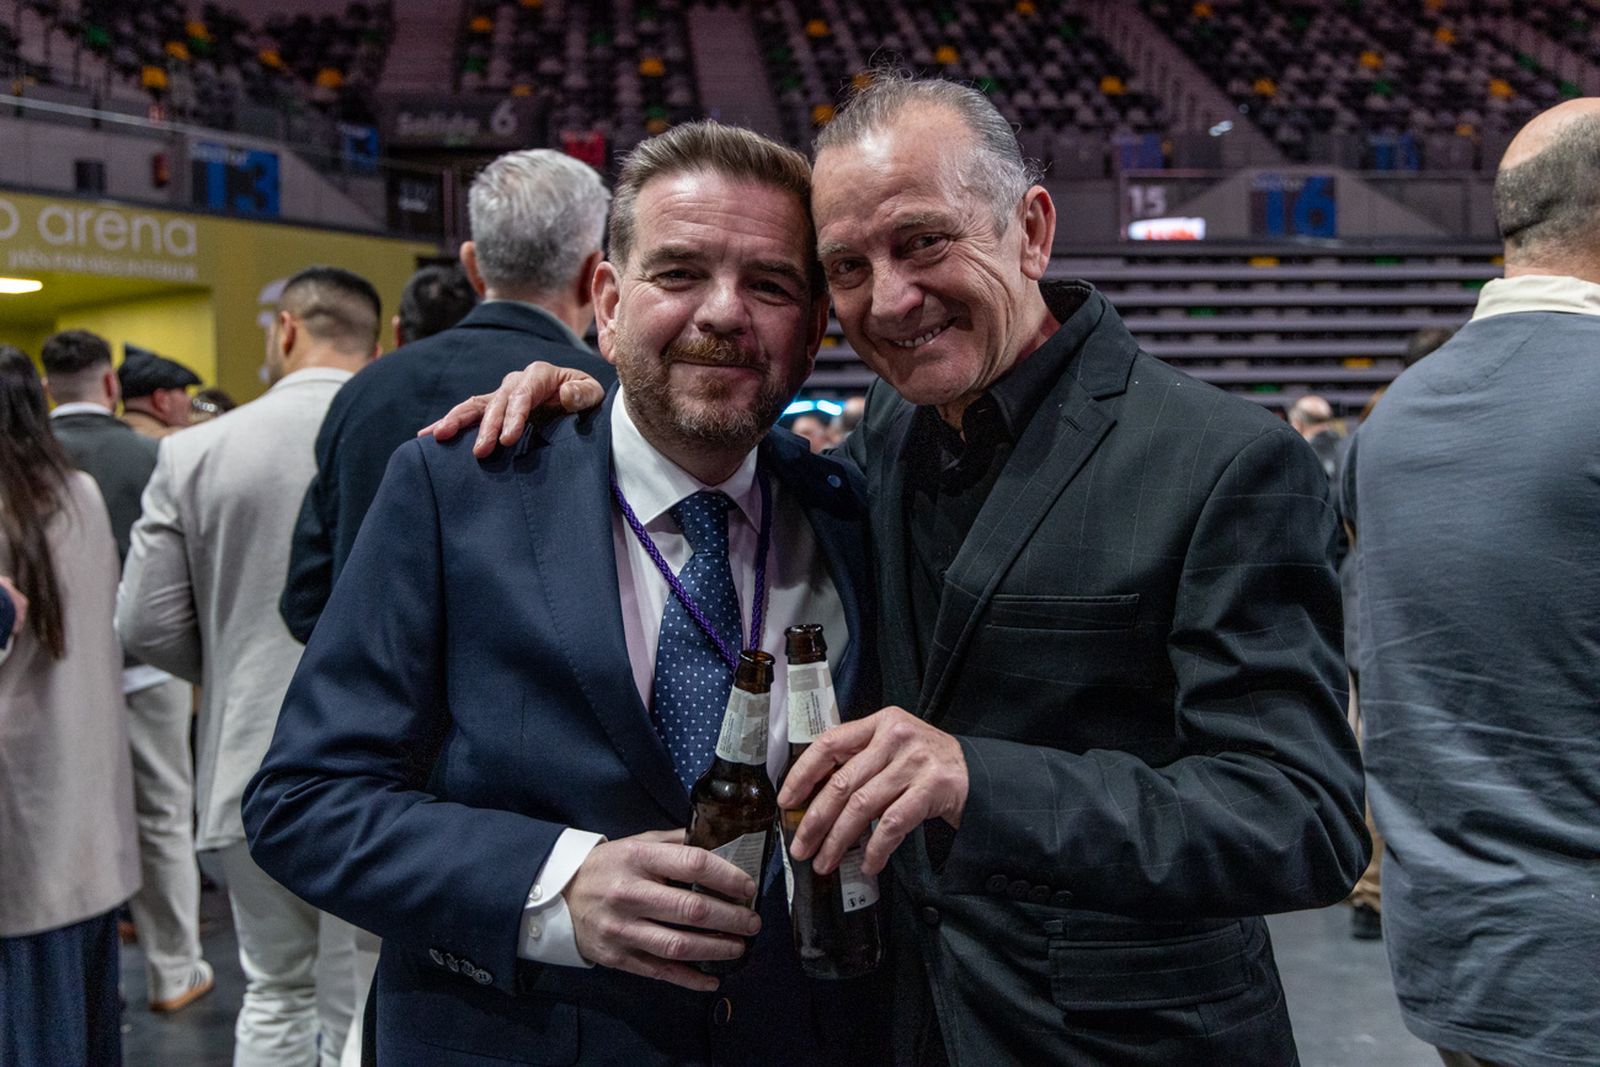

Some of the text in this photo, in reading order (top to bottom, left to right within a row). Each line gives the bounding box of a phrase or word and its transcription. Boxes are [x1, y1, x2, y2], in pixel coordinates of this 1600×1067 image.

[491, 99, 518, 136] 6
[206, 148, 280, 214] 13
[1129, 185, 1167, 216] 15
[1265, 175, 1337, 238] 16
[37, 204, 197, 257] arena
